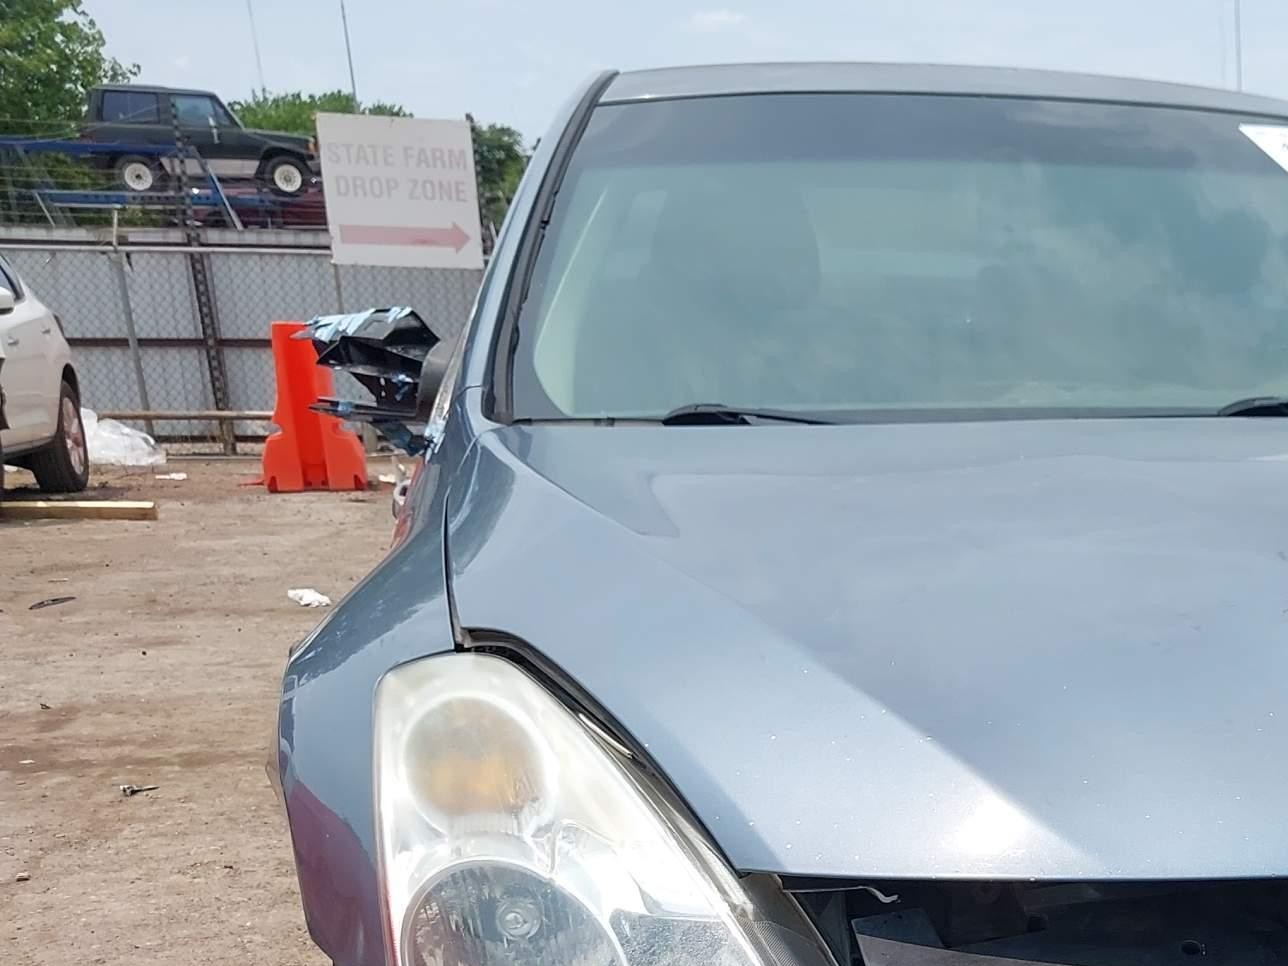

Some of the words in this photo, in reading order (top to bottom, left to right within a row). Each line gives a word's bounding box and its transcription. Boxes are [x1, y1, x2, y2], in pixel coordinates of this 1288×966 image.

[327, 143, 395, 167] STATE
[403, 146, 468, 170] FARM
[335, 175, 399, 198] DROP
[408, 179, 468, 203] ZONE
